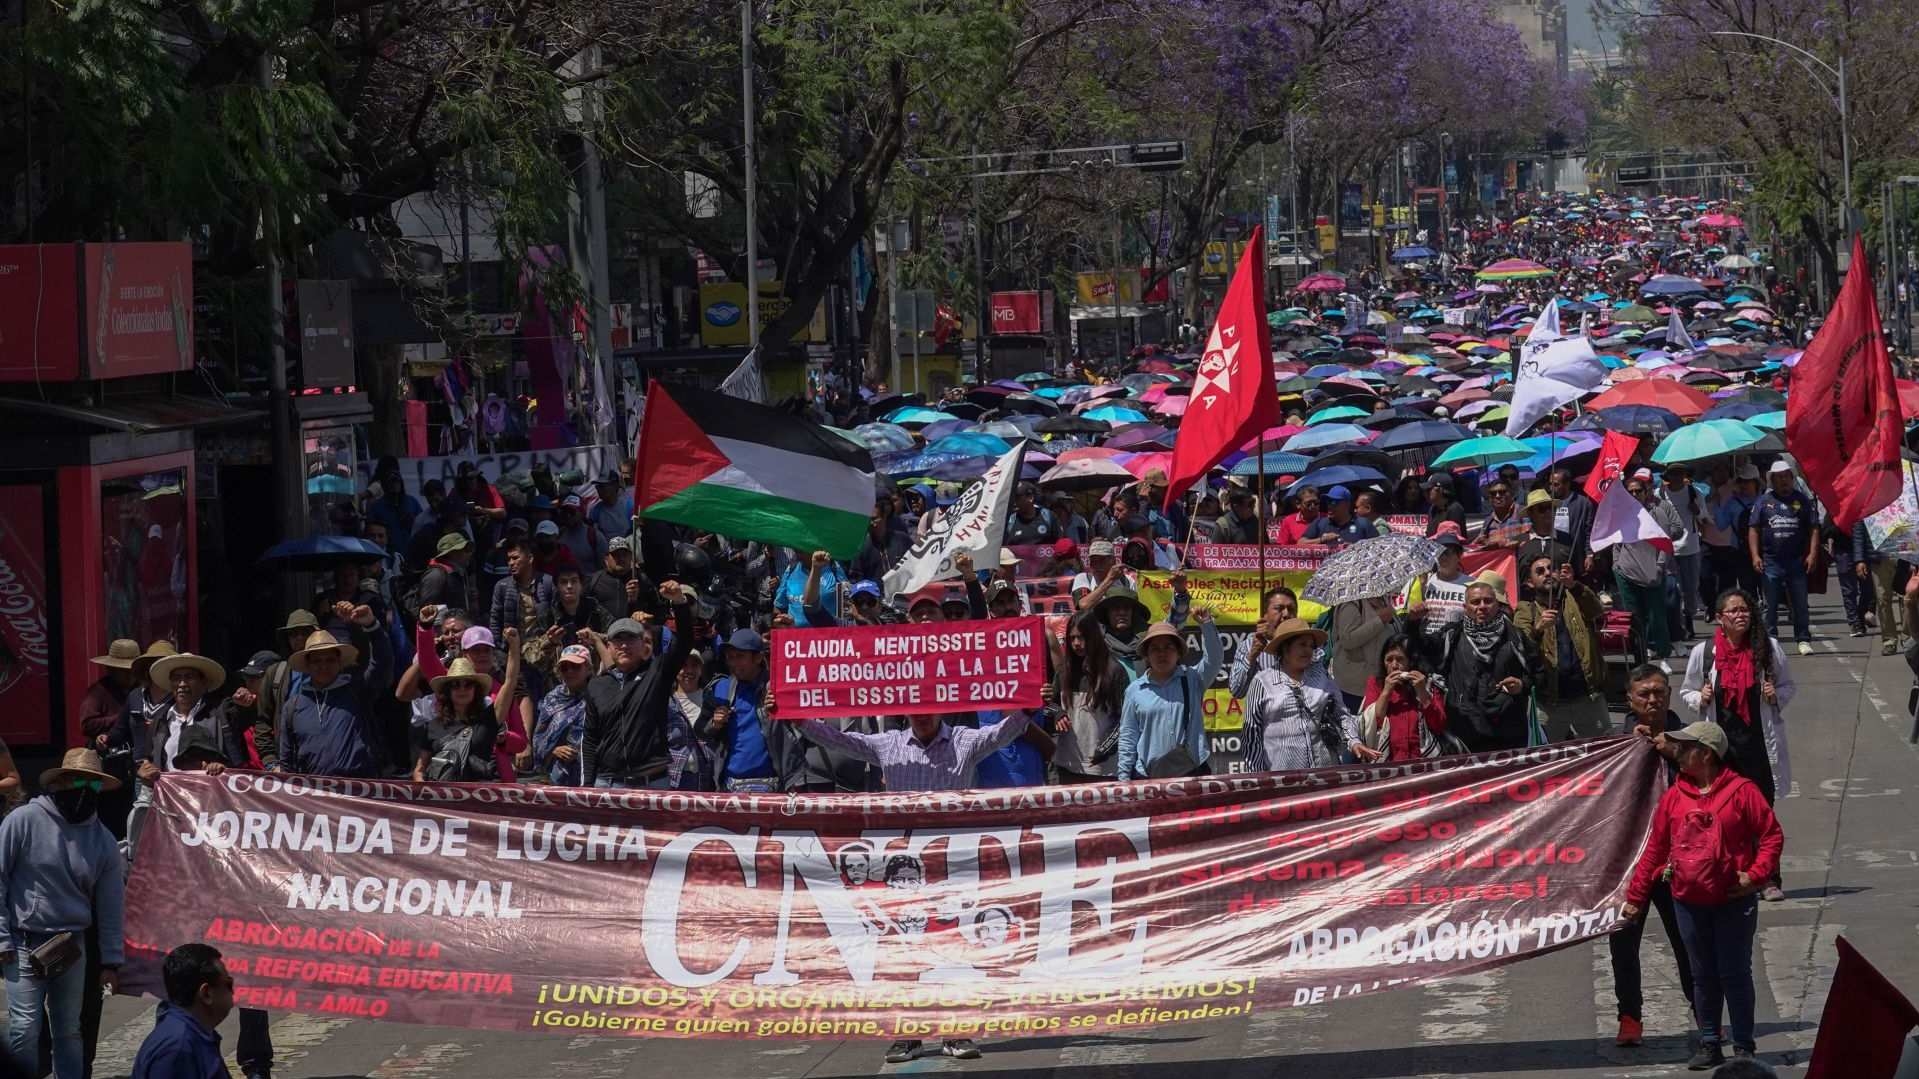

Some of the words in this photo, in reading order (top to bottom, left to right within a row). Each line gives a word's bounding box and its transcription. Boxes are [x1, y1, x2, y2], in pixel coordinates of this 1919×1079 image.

[1204, 558, 1295, 569] TRABAJAORES
[1221, 546, 1312, 558] TRABAADORES
[1142, 577, 1215, 590] Asablea
[784, 640, 861, 659] CLAUDIA,
[874, 631, 986, 656] MENTISSSTE
[995, 629, 1031, 648] CON
[785, 665, 807, 683] LA
[817, 656, 924, 682] ABROGACIÓN
[936, 660, 947, 677] A
[959, 658, 984, 676] LA
[995, 654, 1030, 674] LEY
[800, 688, 835, 707] DEL
[850, 684, 921, 706] ISSSTE
[935, 683, 959, 702] DE
[970, 680, 1019, 700] 2007
[227, 773, 554, 806] COORDINADORA
[565, 789, 773, 814] NACIONAL
[857, 781, 1187, 814] TRABAJADORES
[181, 810, 393, 856] JORNADA
[409, 818, 470, 857] DE
[496, 820, 648, 862] LUCHA
[286, 872, 524, 919] NACIONAL
[203, 916, 386, 955] ABROGACIÓN
[388, 939, 412, 958] DE
[417, 942, 441, 960] LA
[254, 956, 371, 988] REFORMA
[376, 968, 514, 996] EDUCATIVA
[234, 984, 297, 1009] PEÑA
[319, 995, 390, 1017] AMLO
[698, 989, 720, 1008] Y
[1293, 985, 1328, 1007] DE
[675, 1015, 750, 1035] quien
[757, 1014, 885, 1036] gobierne,
[895, 1015, 932, 1034] los
[939, 1013, 1061, 1034] derechos
[1068, 1013, 1098, 1028] se
[1106, 1001, 1253, 1026] defienden!
